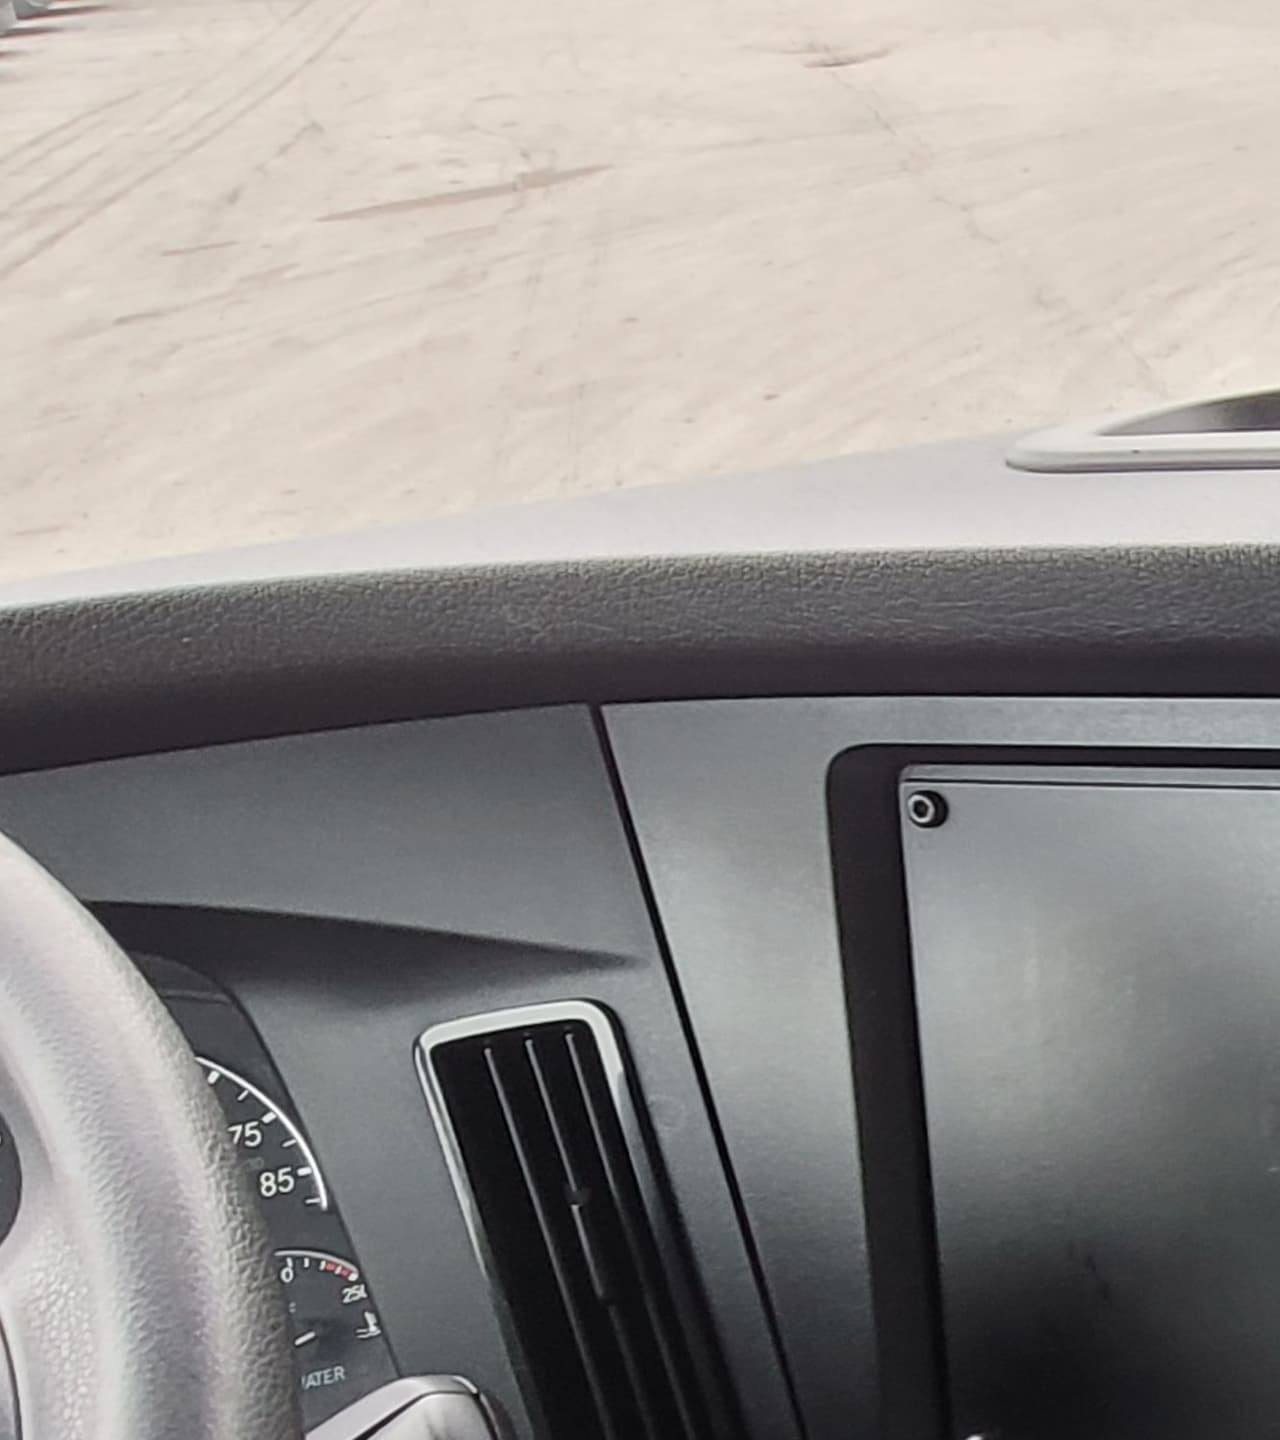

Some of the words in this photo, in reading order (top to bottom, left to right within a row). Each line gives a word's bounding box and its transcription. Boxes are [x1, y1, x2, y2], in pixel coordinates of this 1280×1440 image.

[227, 1120, 263, 1148] 75
[260, 1167, 295, 1198] 85
[302, 1365, 346, 1391] ATER
